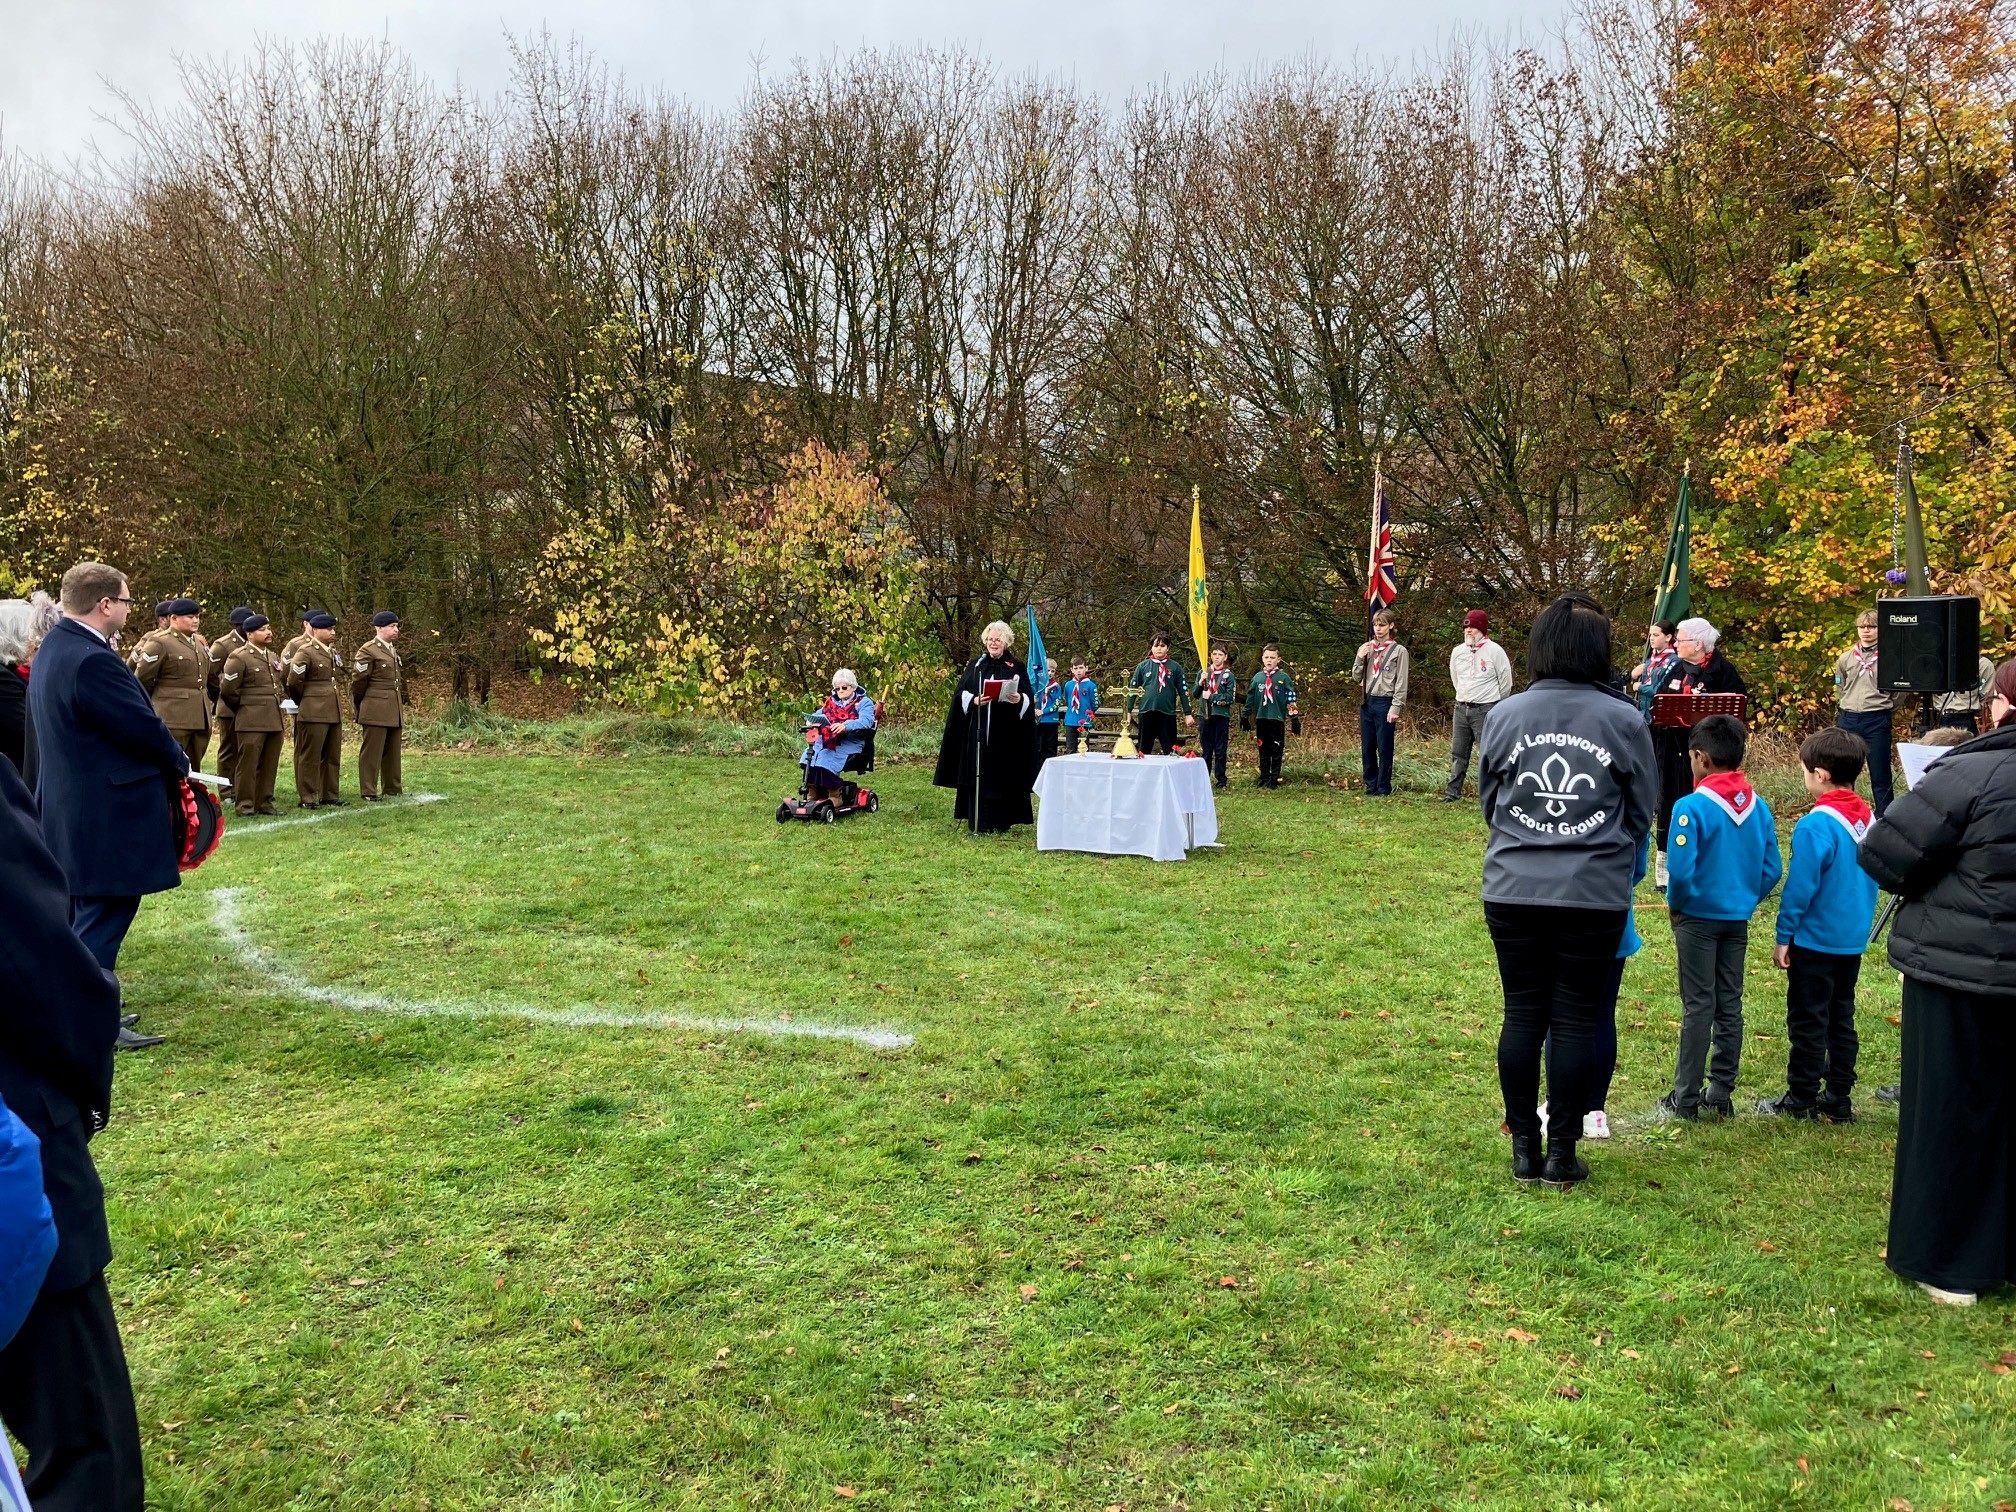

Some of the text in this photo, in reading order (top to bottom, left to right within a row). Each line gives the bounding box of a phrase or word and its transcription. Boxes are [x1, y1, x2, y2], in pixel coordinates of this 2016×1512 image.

[1889, 614, 1918, 623] Roland
[1524, 732, 1613, 768] Longworth
[1509, 805, 1606, 836] Scout Group
